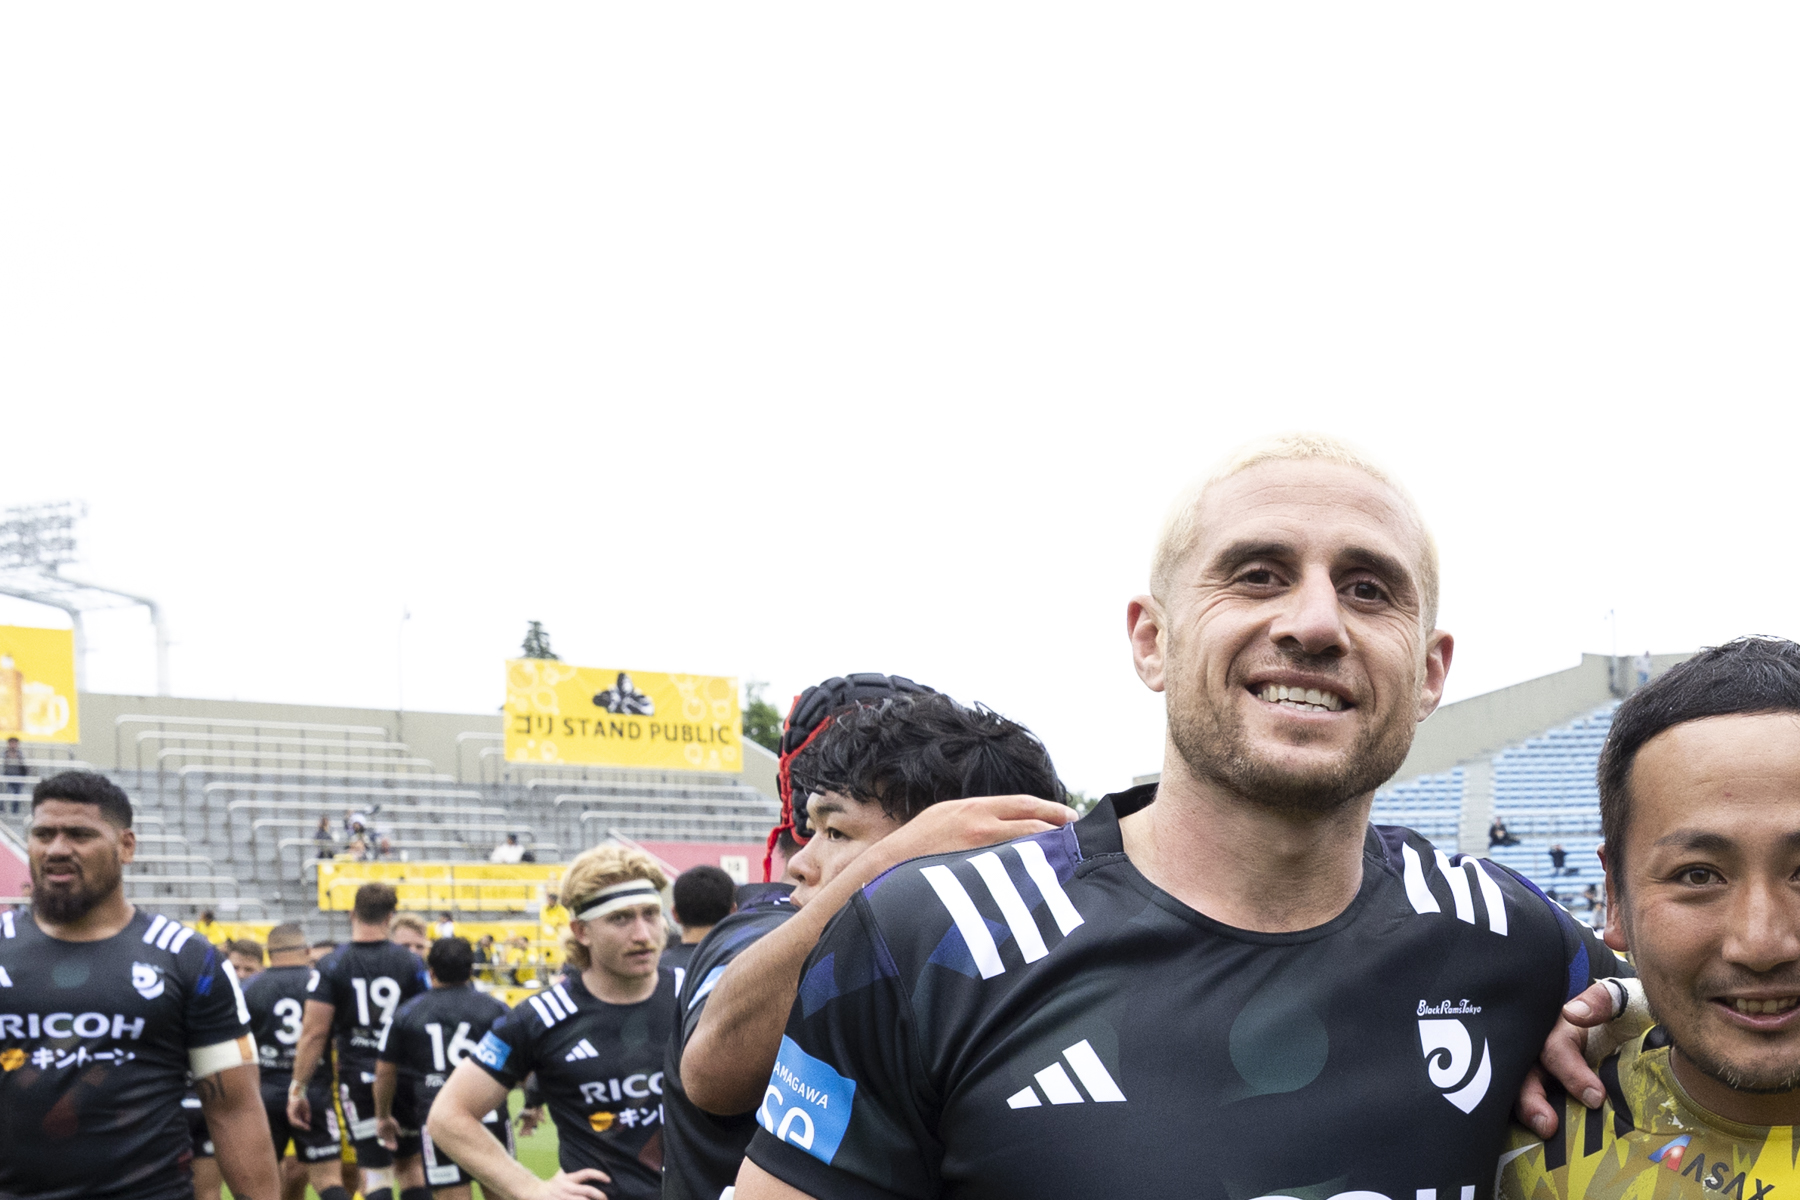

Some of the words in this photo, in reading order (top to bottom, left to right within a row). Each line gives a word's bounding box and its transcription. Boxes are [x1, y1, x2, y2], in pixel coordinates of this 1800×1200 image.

[563, 717, 642, 739] STAND
[650, 722, 731, 744] PUBLIC
[351, 976, 401, 1026] 19
[0, 1012, 146, 1040] RICOH
[273, 997, 304, 1045] 3
[31, 1046, 136, 1070] キントーン
[425, 1021, 478, 1071] 16
